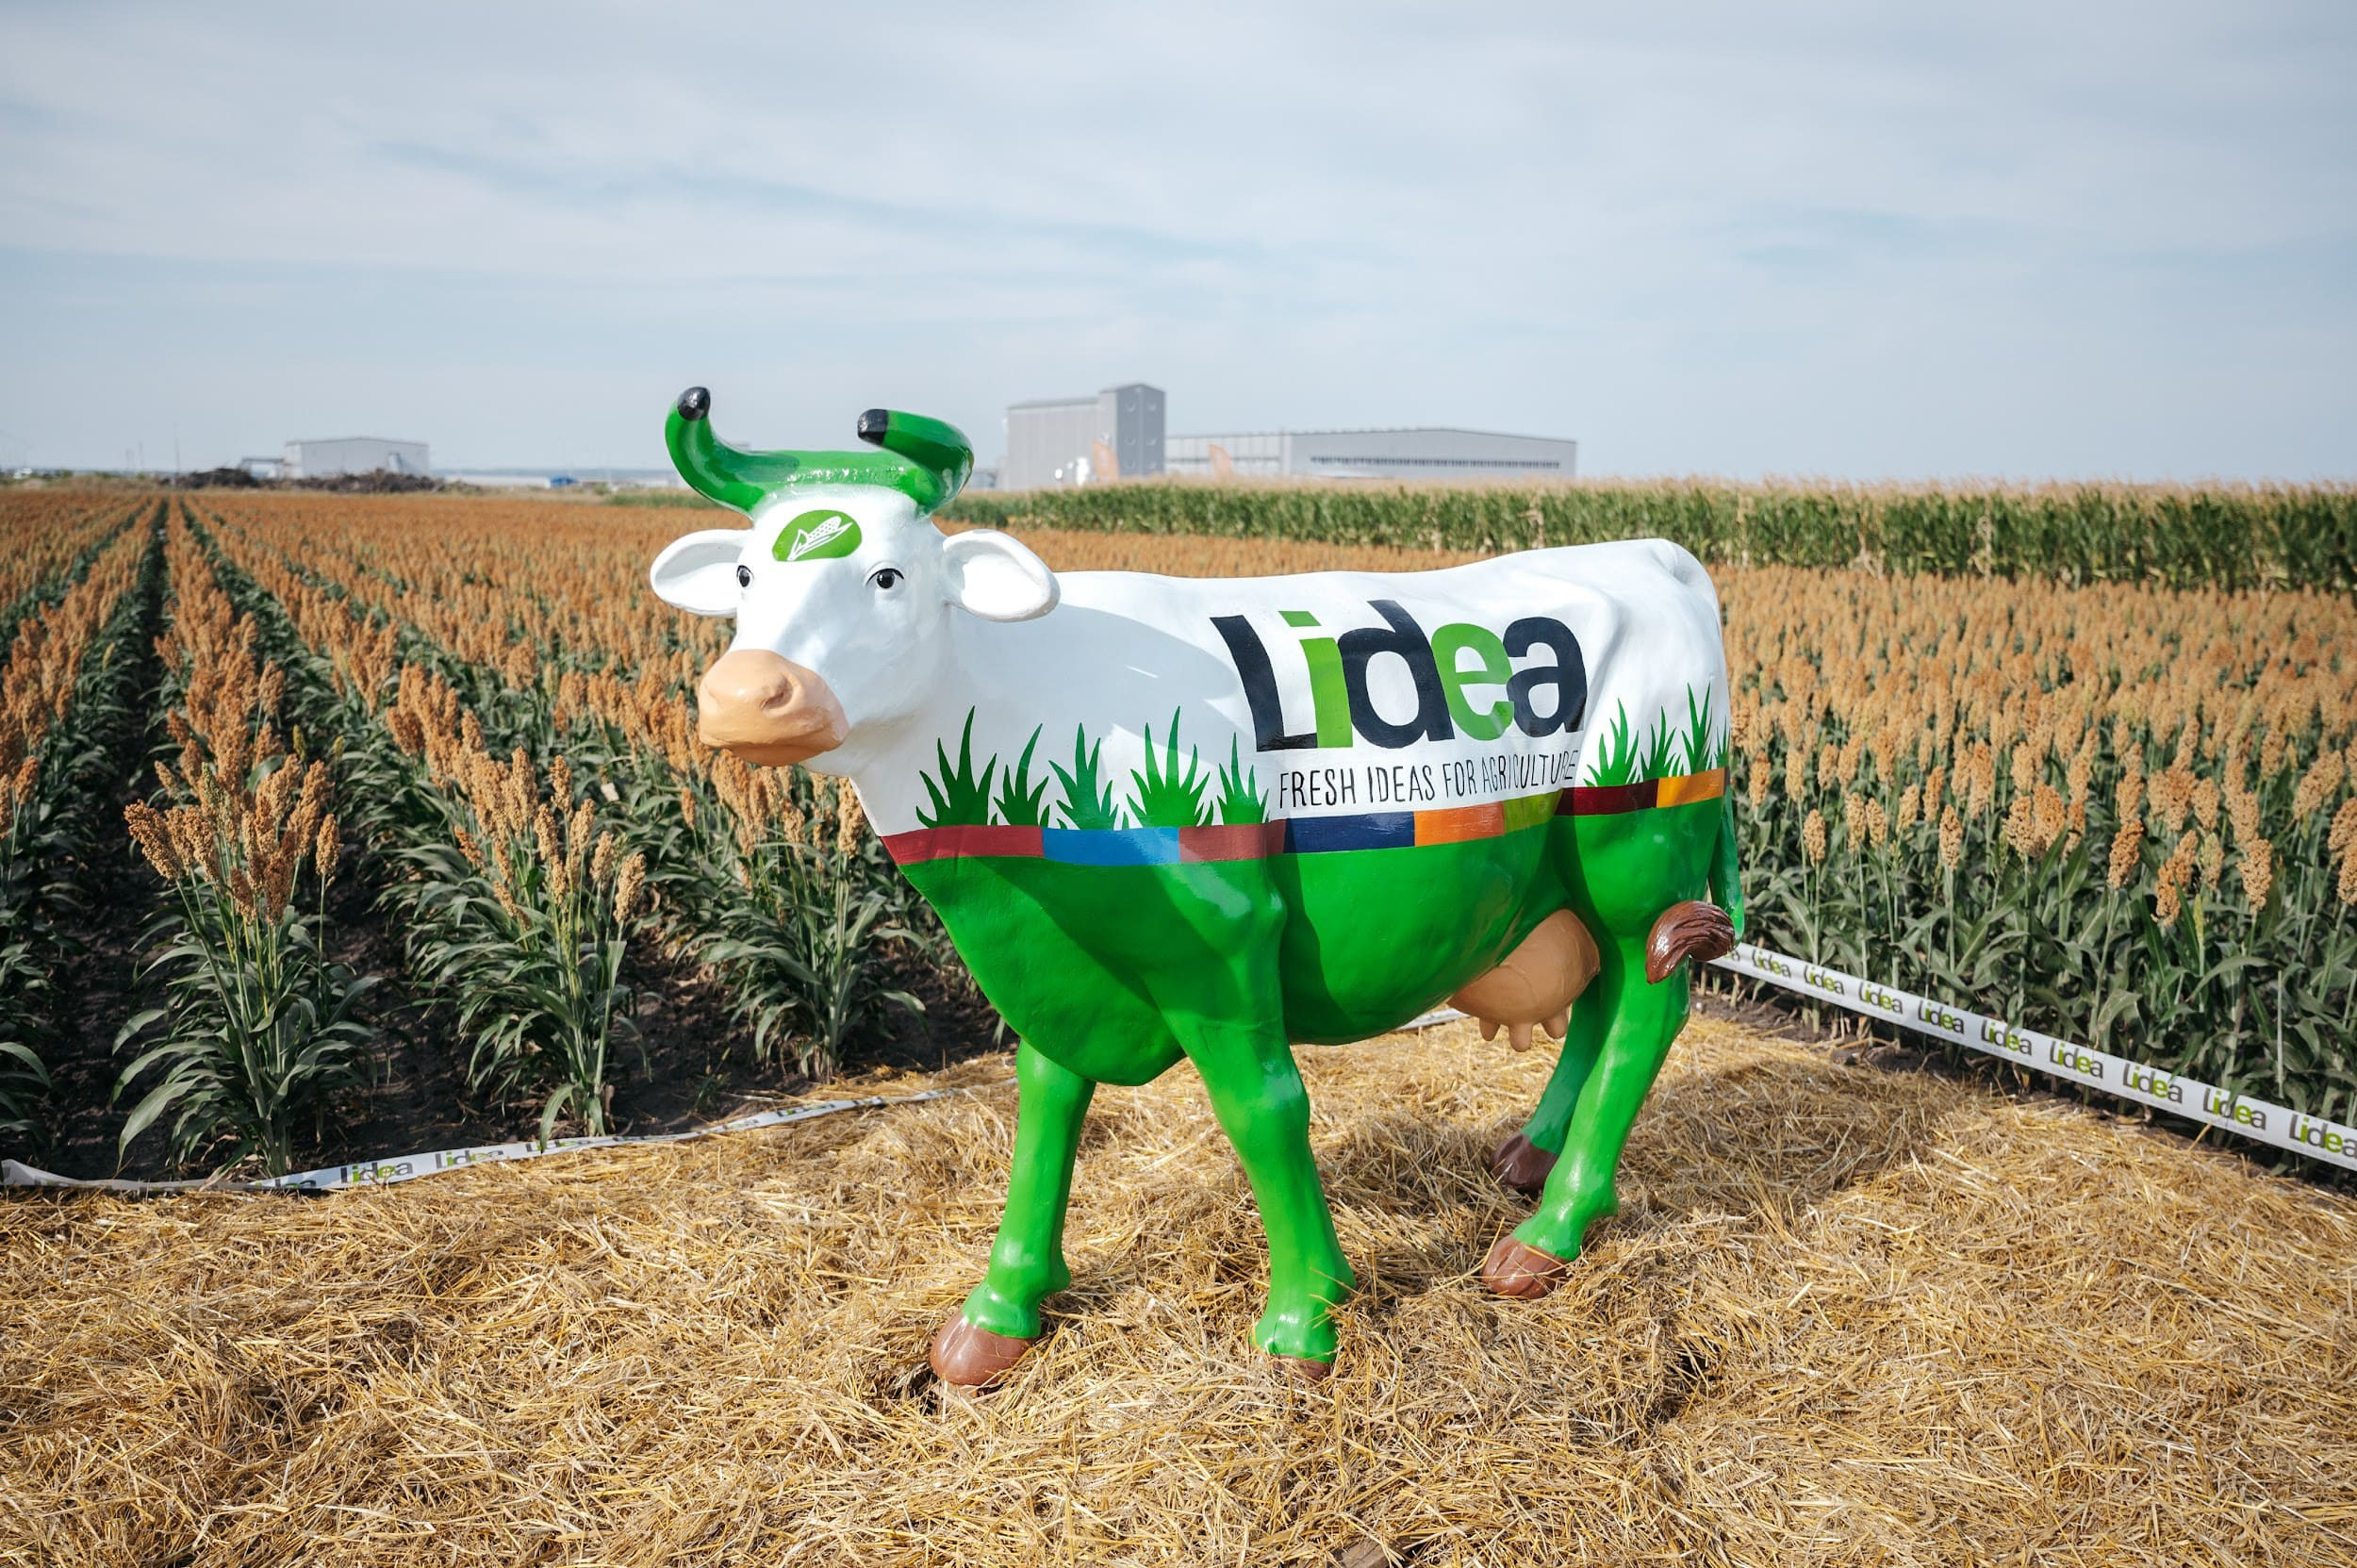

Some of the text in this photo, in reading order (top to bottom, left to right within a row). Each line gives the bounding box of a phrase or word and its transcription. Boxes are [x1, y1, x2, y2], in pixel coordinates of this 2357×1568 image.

[1210, 600, 1588, 752] Lidea
[1279, 750, 1579, 809] FRESH IDEAS FOR AGRICULTURE
[1752, 949, 1791, 978] Lidea
[1804, 964, 1845, 996] Lidea
[1858, 982, 1904, 1015] Lidea
[1918, 1000, 1965, 1035] Lidea
[1981, 1019, 2033, 1057] Lidea
[2050, 1040, 2104, 1080] Lidea
[2123, 1062, 2184, 1104] Lidea
[2203, 1087, 2266, 1131] Lidea
[2289, 1114, 2357, 1160] Lidea
